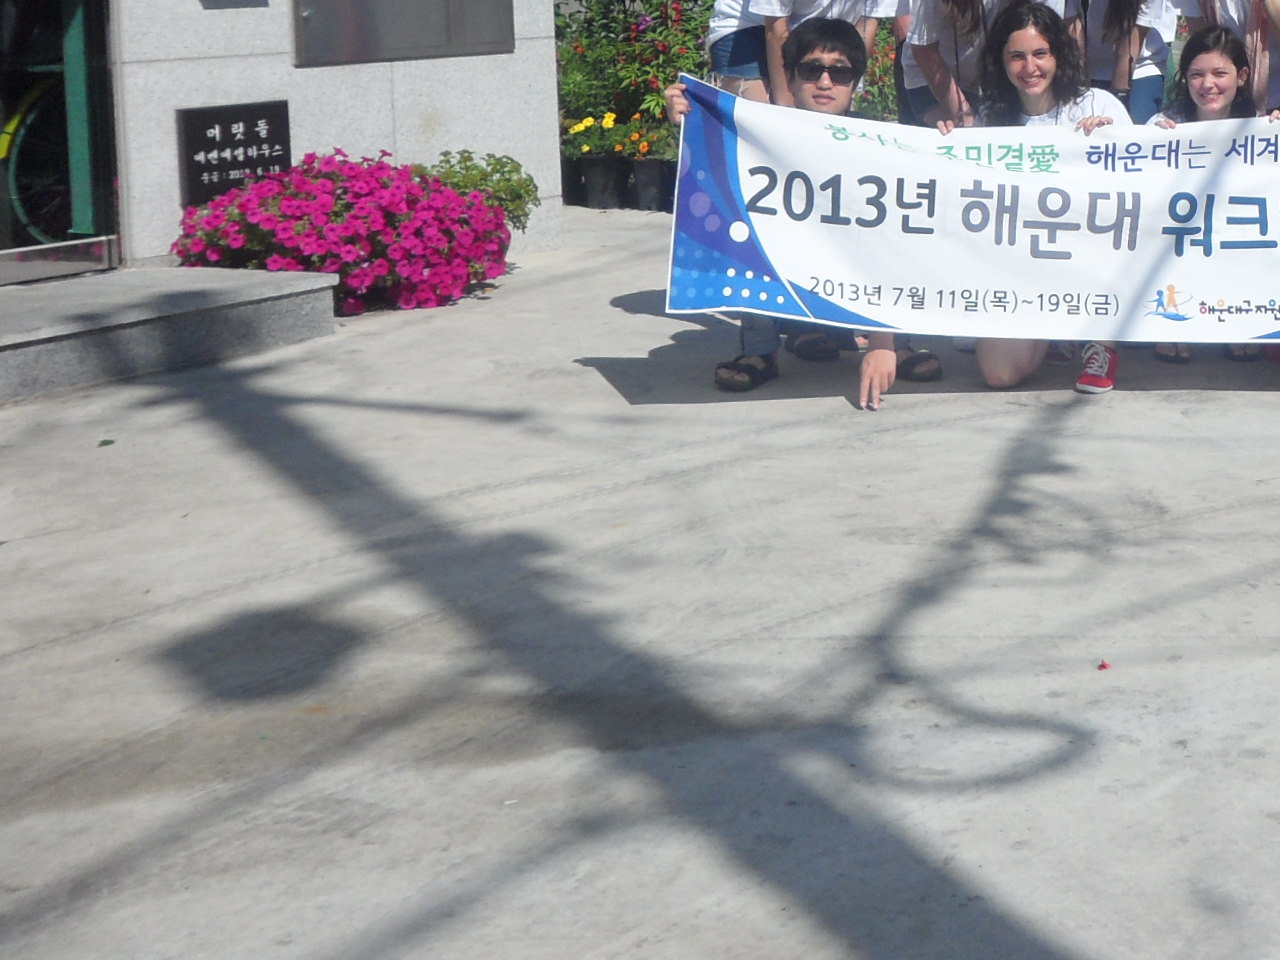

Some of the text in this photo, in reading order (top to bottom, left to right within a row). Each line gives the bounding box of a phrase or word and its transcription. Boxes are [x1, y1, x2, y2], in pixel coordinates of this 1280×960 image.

[1086, 136, 1212, 173] 해운대는
[746, 164, 937, 235] 2013년
[959, 179, 1142, 260] 해운대
[808, 276, 883, 306] 2013년
[891, 285, 927, 311] 7월
